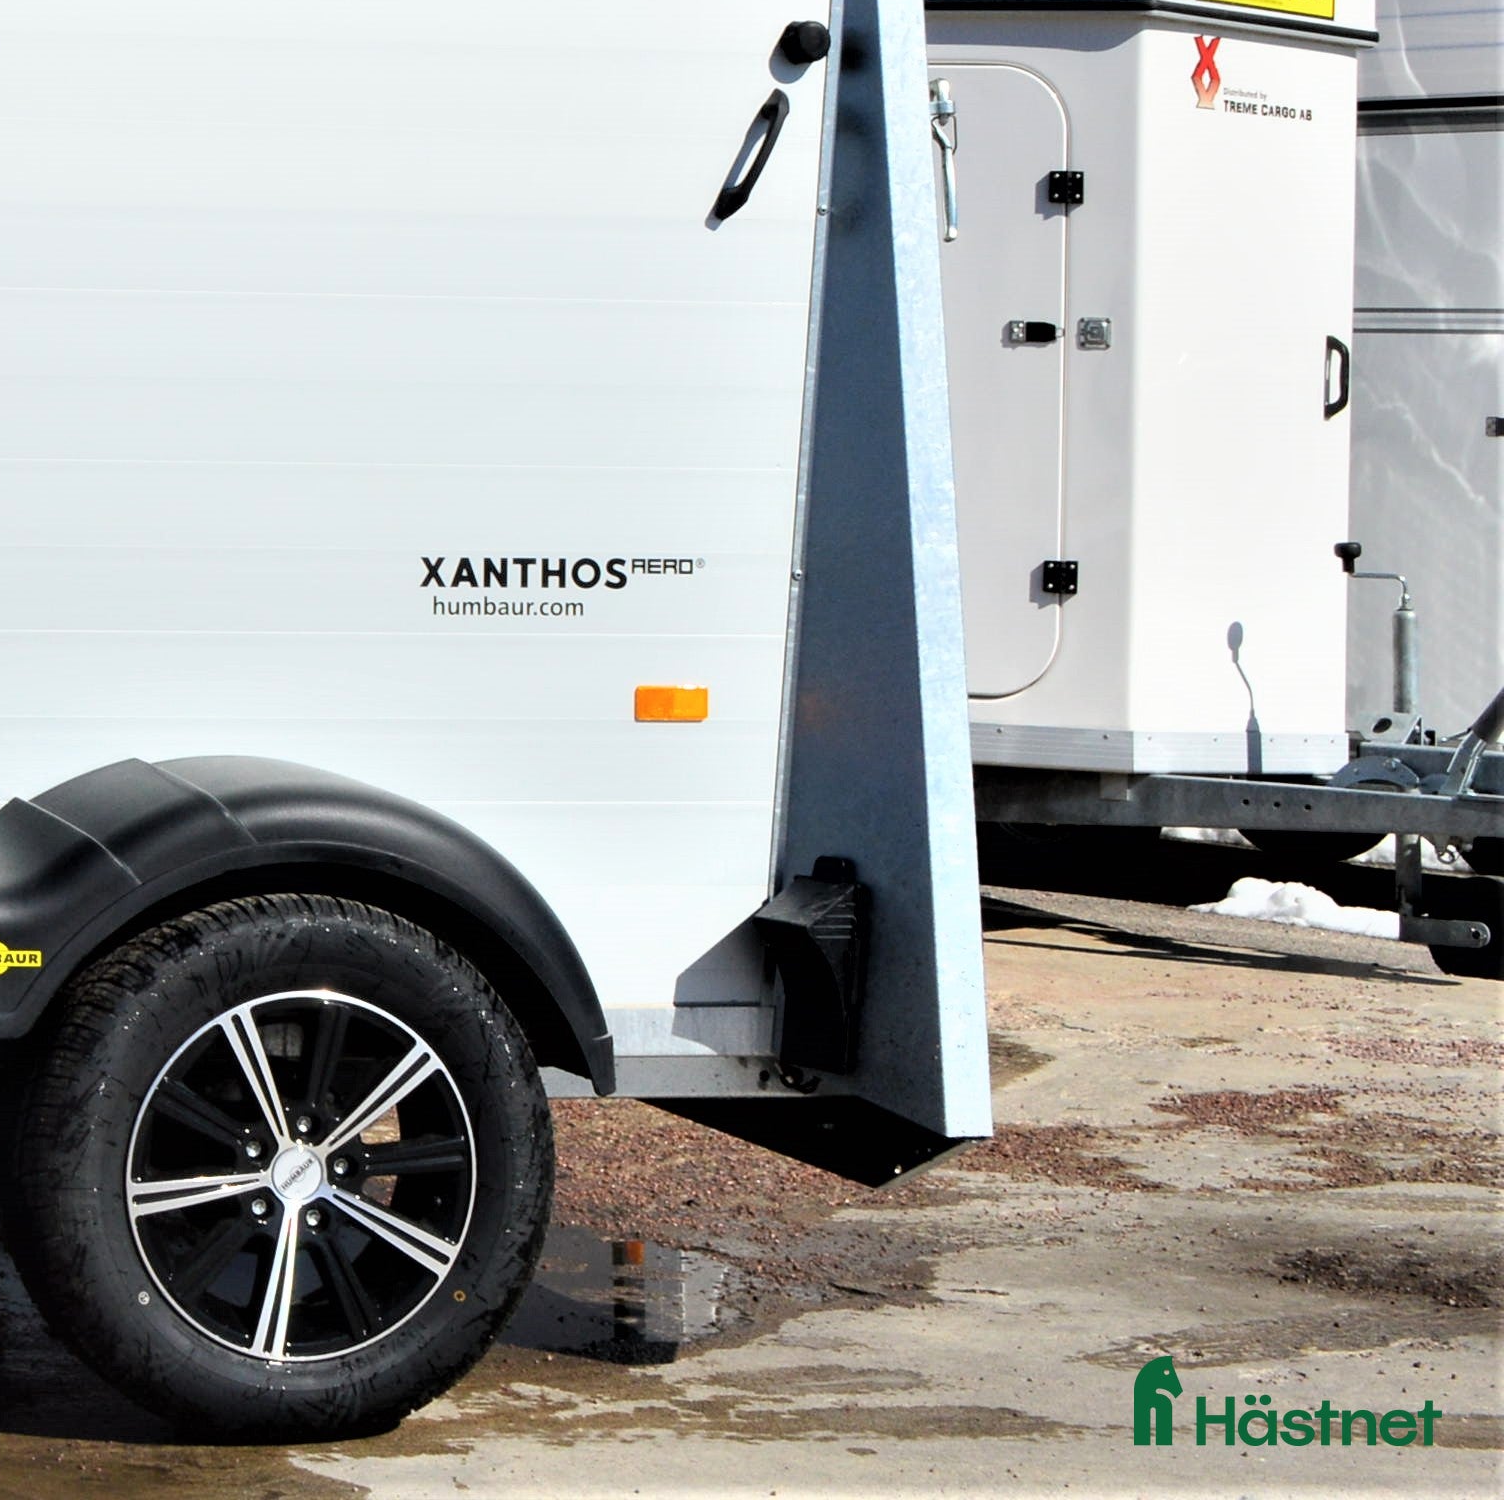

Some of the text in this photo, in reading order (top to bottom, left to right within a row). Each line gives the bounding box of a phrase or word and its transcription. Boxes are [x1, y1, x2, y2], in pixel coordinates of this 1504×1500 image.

[1260, 104, 1296, 119] CARGO
[1299, 109, 1312, 121] AB
[419, 556, 628, 590] XANTHOS
[432, 595, 585, 617] humbaur.com
